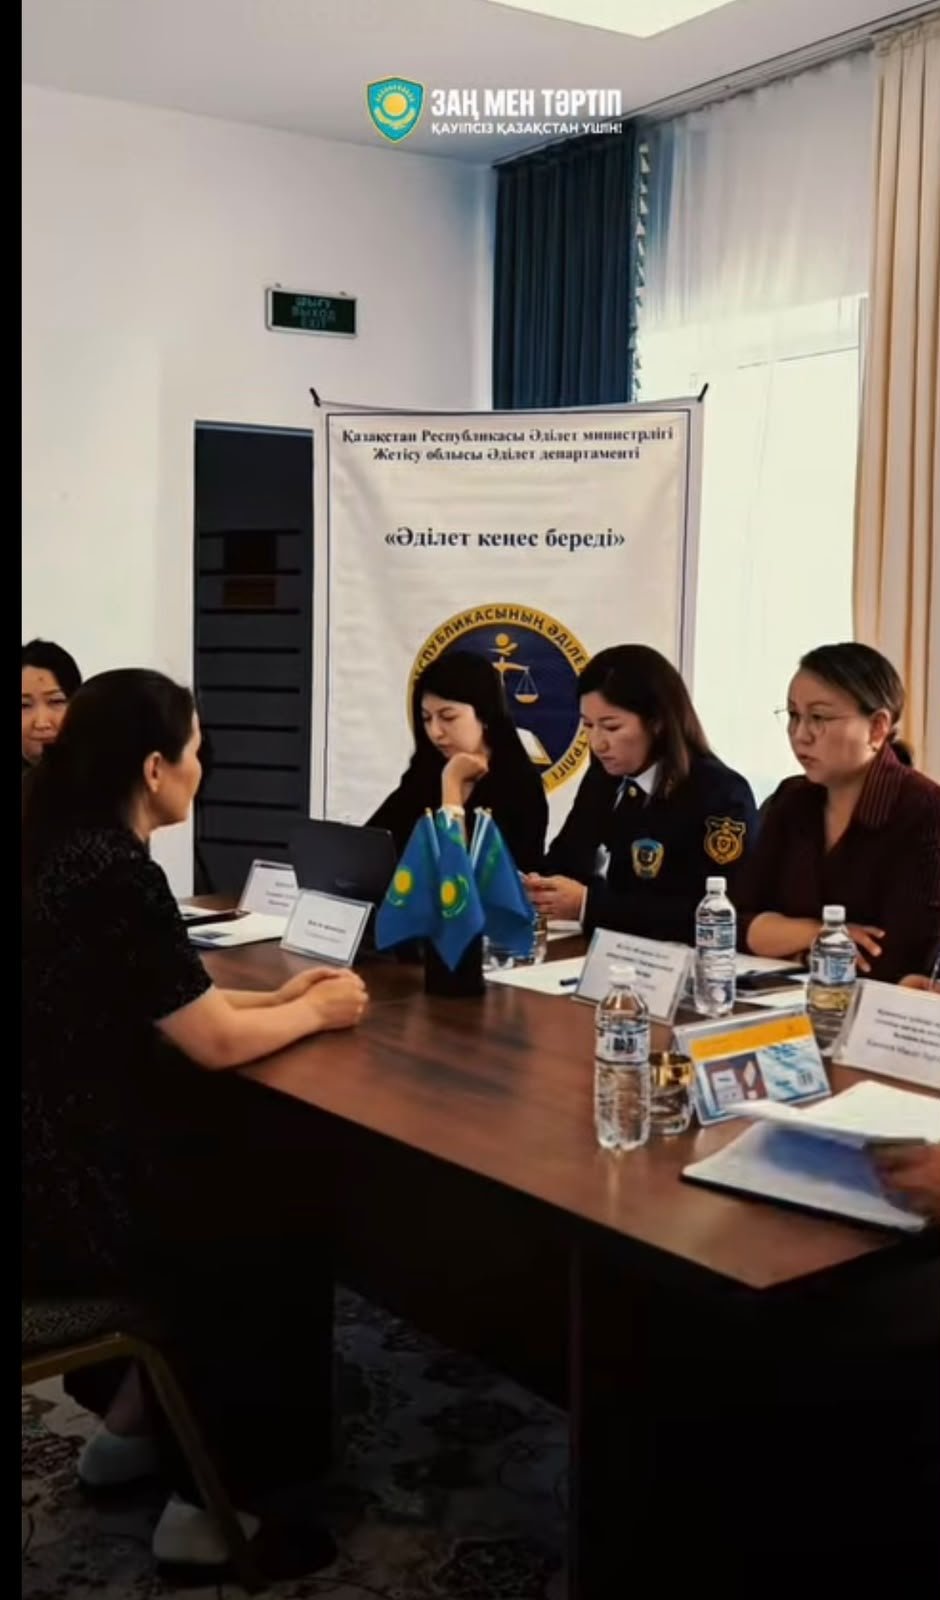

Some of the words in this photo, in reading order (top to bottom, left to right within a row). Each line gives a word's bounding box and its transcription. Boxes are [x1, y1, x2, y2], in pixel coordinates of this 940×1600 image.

[342, 429, 417, 444] Қазақстан
[422, 429, 525, 445] Республикасы
[529, 429, 577, 443] Әділет
[583, 427, 674, 443] министрлігі
[372, 448, 421, 464] Жетісу
[426, 448, 483, 461] облысы
[487, 448, 535, 461] Әділет
[539, 447, 640, 463] департаменті
[384, 527, 471, 547] «Әділет
[477, 532, 539, 549] кеңес
[545, 528, 625, 552] береді»
